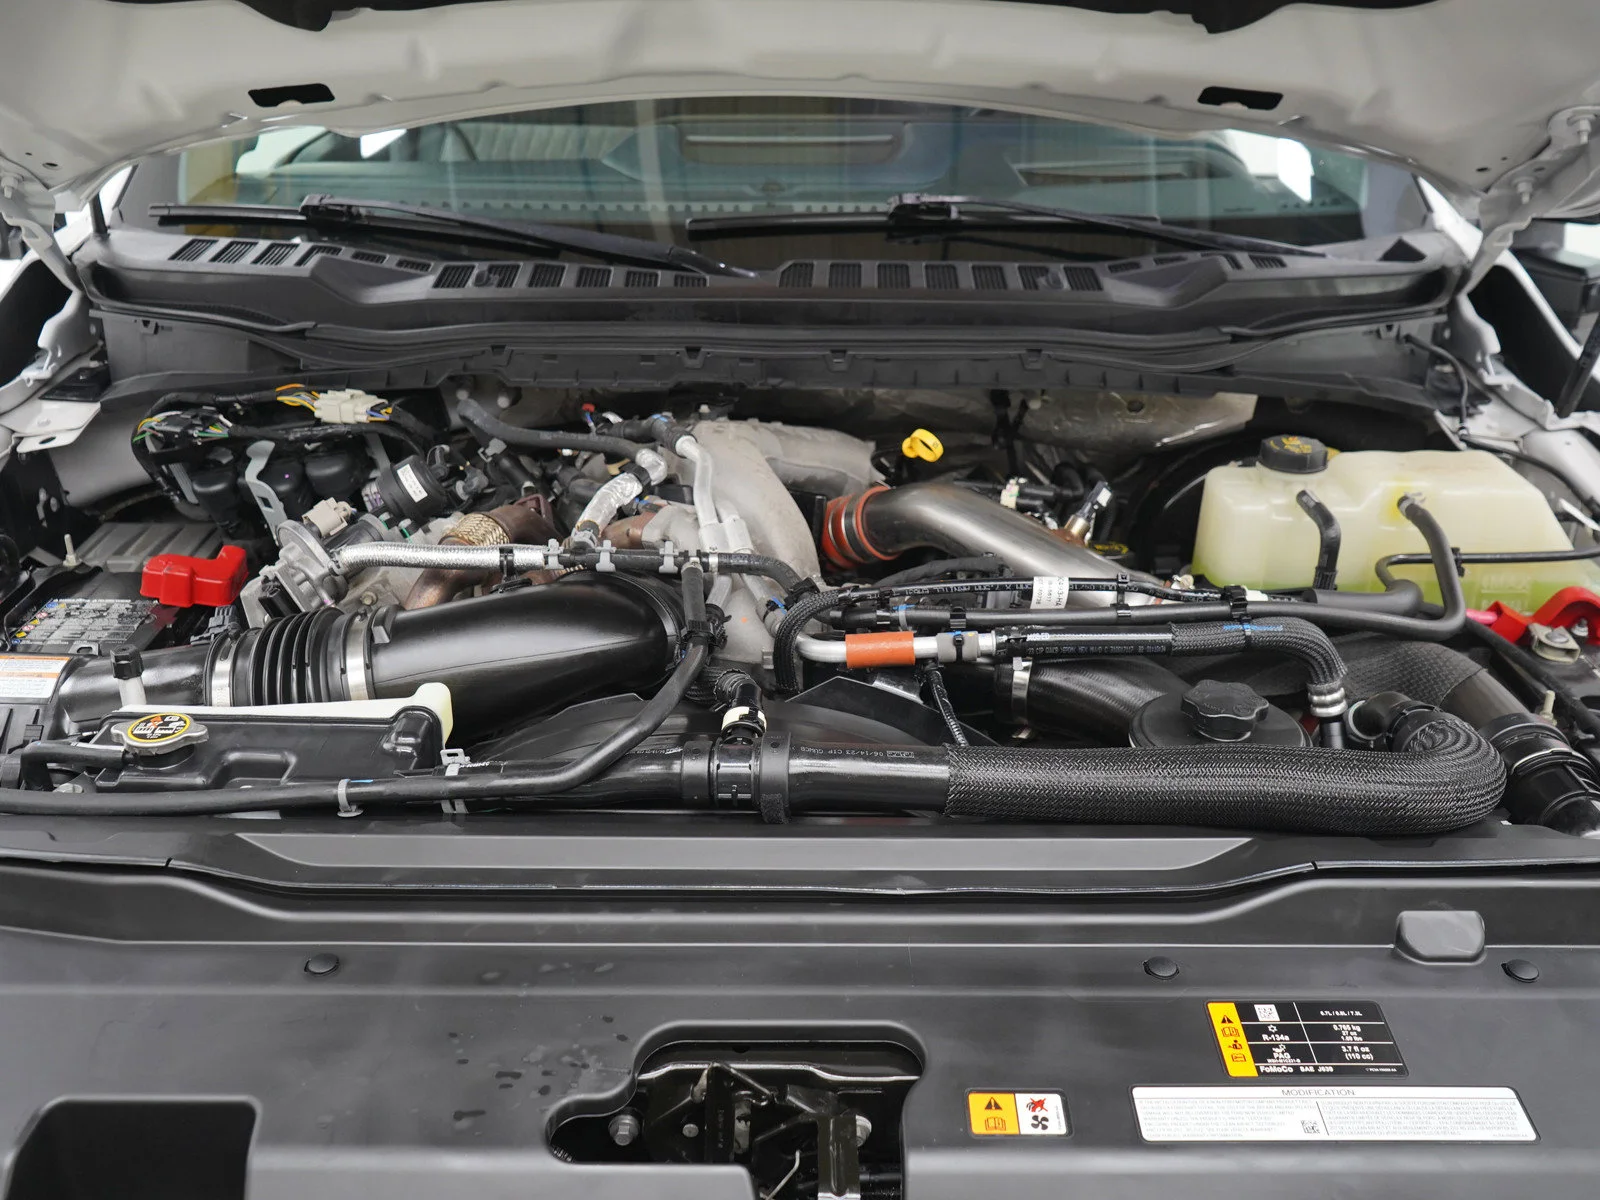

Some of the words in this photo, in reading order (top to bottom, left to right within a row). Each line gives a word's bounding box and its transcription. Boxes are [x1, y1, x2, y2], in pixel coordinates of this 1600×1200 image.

[1351, 1024, 1361, 1032] kg
[1344, 1052, 1361, 1060] (110
[1260, 1065, 1294, 1073] FoMoCo
[1281, 1088, 1356, 1096] MODIFICATION
